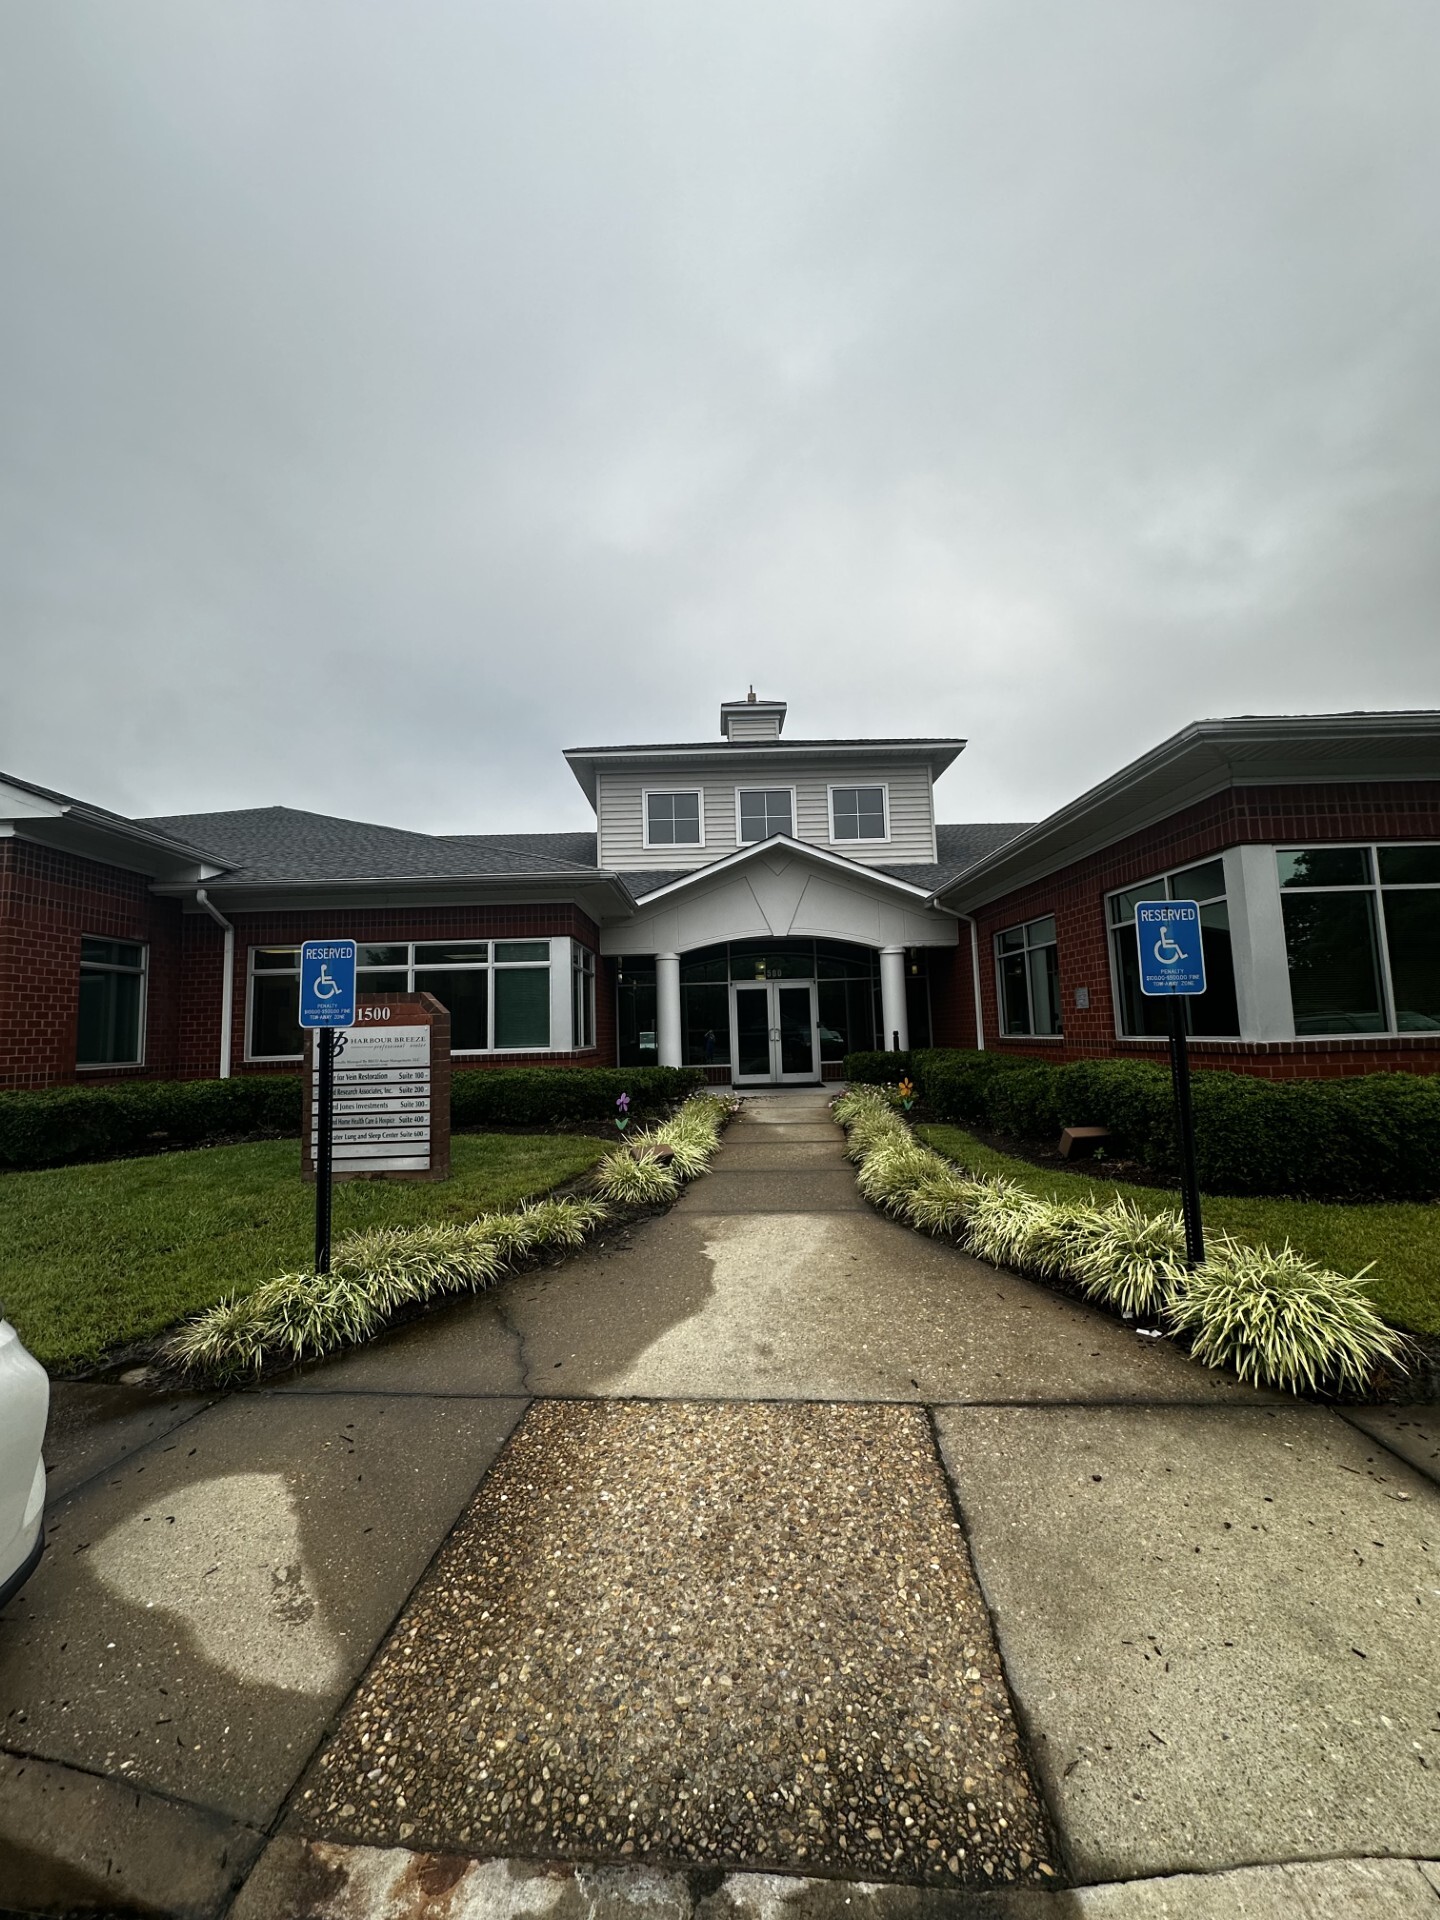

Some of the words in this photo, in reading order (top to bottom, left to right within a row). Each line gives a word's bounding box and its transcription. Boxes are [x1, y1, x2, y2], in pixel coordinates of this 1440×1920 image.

[1141, 908, 1195, 922] RESERVED
[306, 947, 353, 960] RESERVED
[357, 1006, 391, 1021] 1500
[336, 1073, 345, 1081] for
[358, 1072, 388, 1080] Restoration
[399, 1072, 413, 1080] Suite
[337, 1087, 358, 1095] Research
[399, 1086, 413, 1094] Suite
[340, 1102, 355, 1111] Jones
[400, 1100, 415, 1108] Suite
[399, 1115, 413, 1123] Suite
[344, 1133, 357, 1141] Lung
[368, 1132, 382, 1140] Sleep
